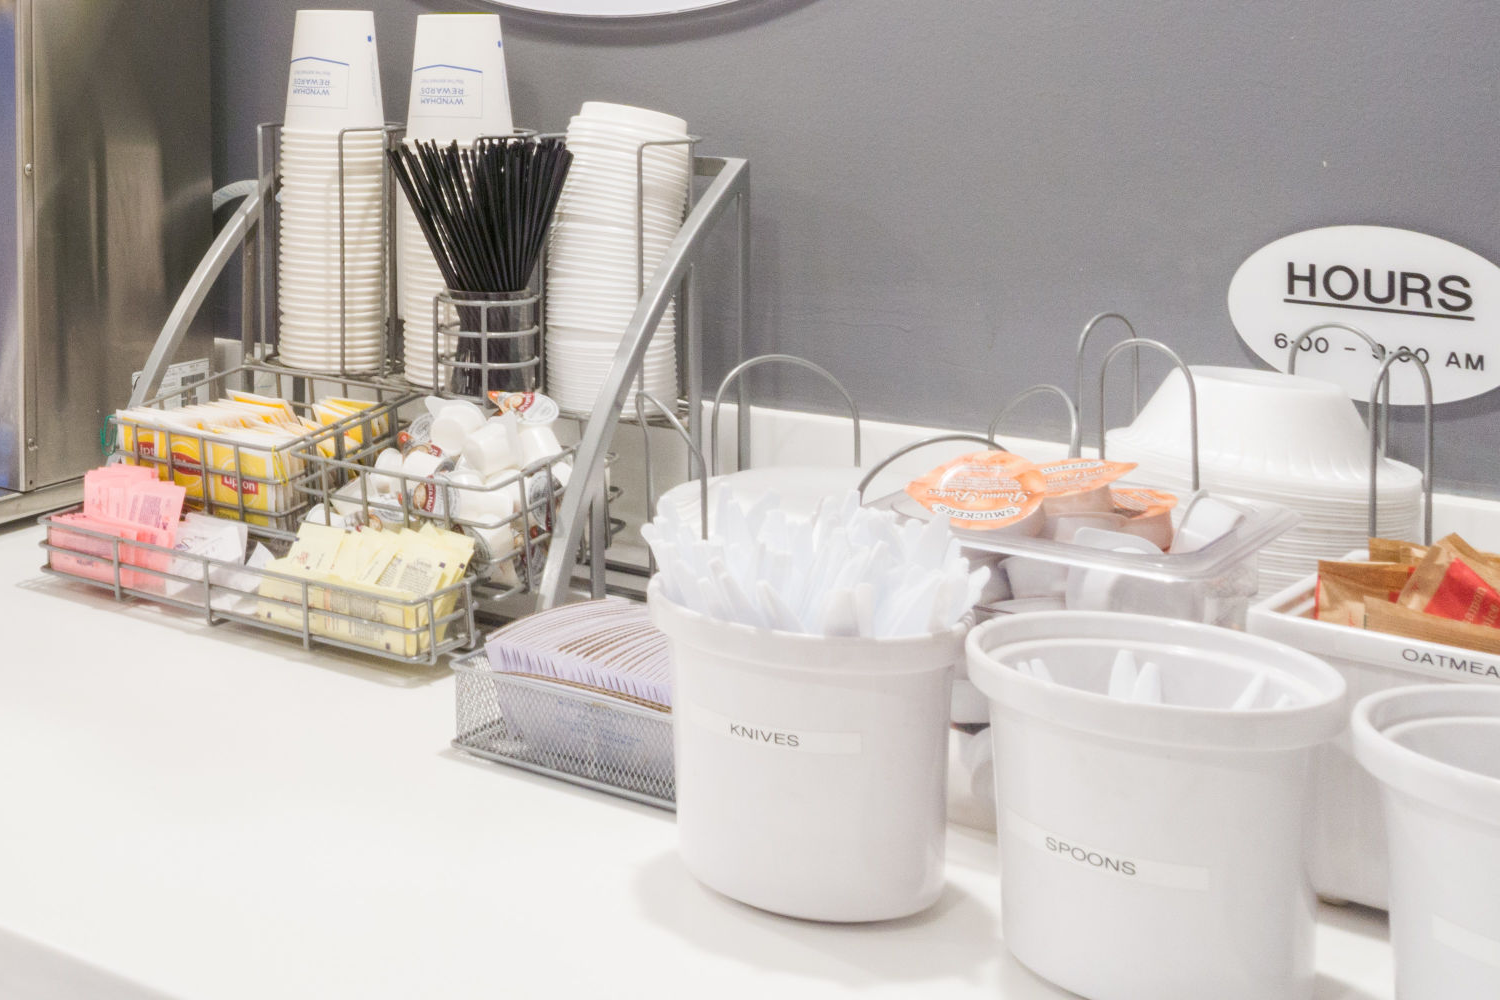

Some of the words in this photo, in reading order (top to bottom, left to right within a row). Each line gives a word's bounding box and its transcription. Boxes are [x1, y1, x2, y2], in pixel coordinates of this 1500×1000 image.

[421, 87, 464, 95] REWARDS
[421, 97, 464, 105] WYNDHAM
[1287, 262, 1474, 313] HOURS
[1274, 332, 1329, 354] 6:00
[1445, 352, 1485, 372] AM
[1402, 648, 1500, 679] OATMEA
[729, 722, 800, 748] KNIVES
[1045, 836, 1137, 876] SPOONS
